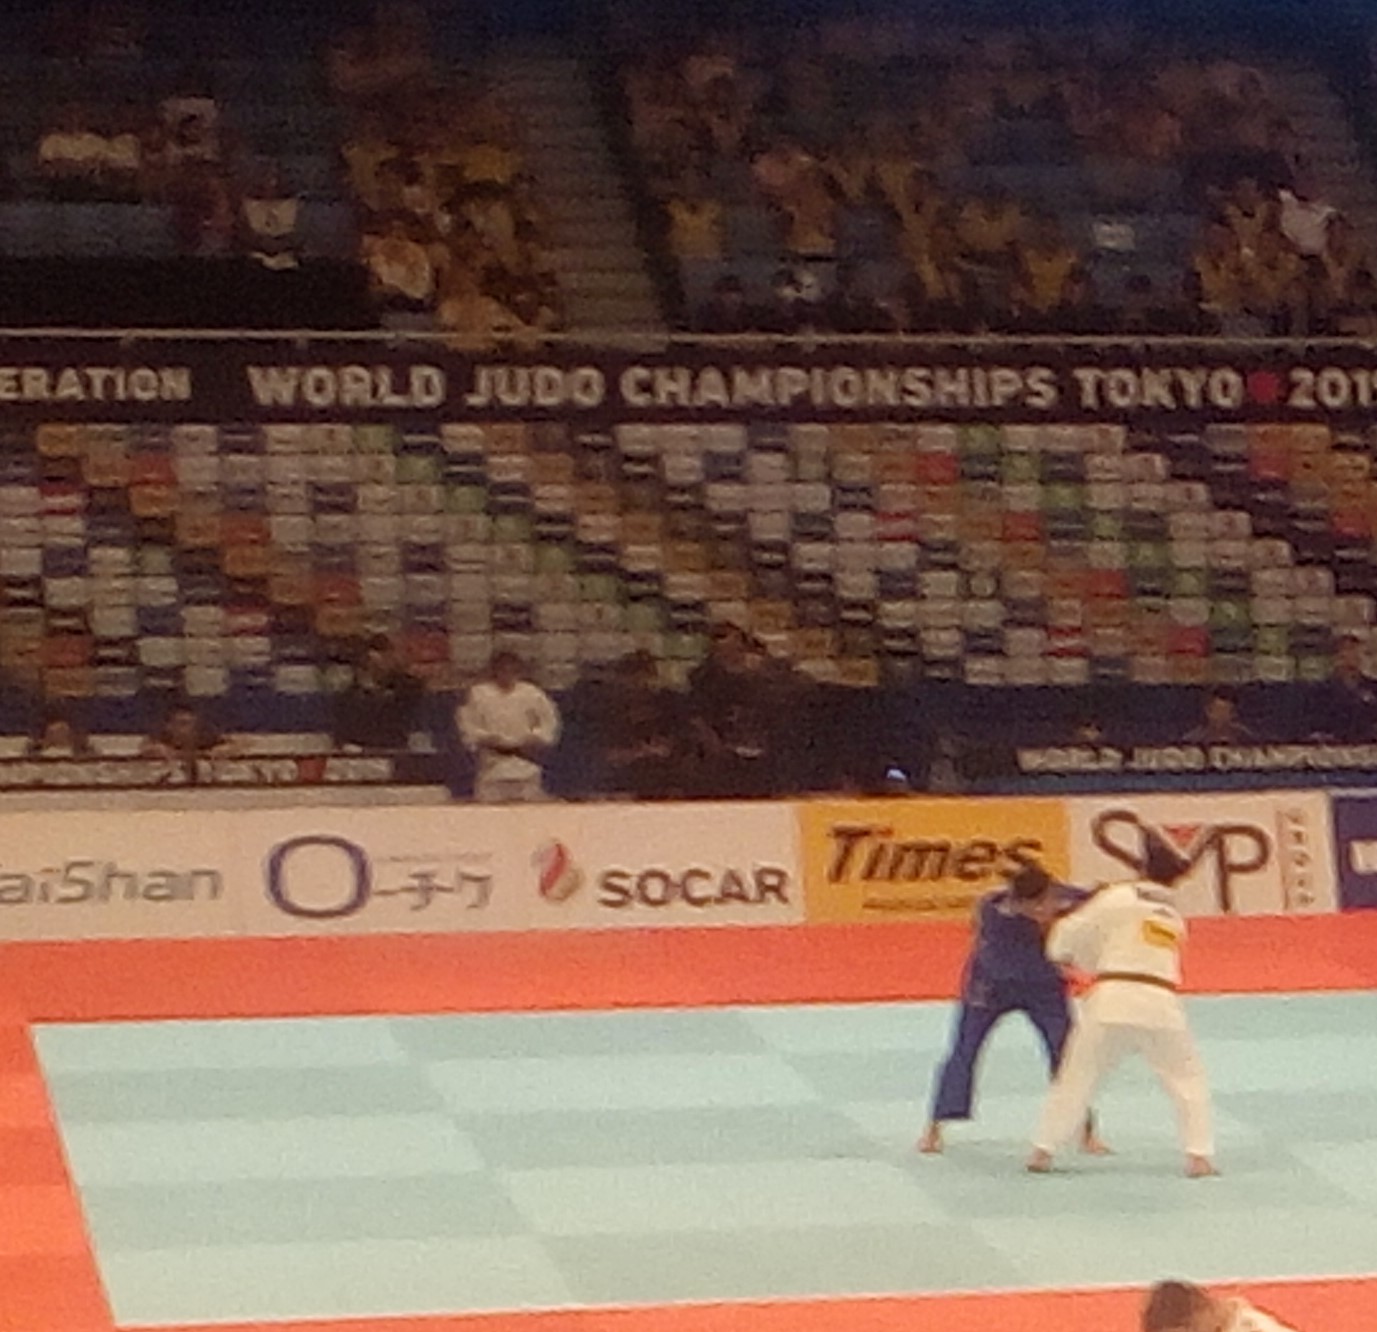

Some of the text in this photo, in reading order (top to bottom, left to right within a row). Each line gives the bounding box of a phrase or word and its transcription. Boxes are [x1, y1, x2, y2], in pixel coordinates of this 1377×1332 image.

[0, 366, 192, 400] ERATION
[247, 365, 445, 406] WORLD
[464, 366, 604, 406] JUDO
[619, 365, 1058, 408] CHAMPIONSHIPS
[1073, 367, 1242, 408] TOKYO
[826, 825, 1043, 884] Times
[599, 866, 790, 907] SOCAR
